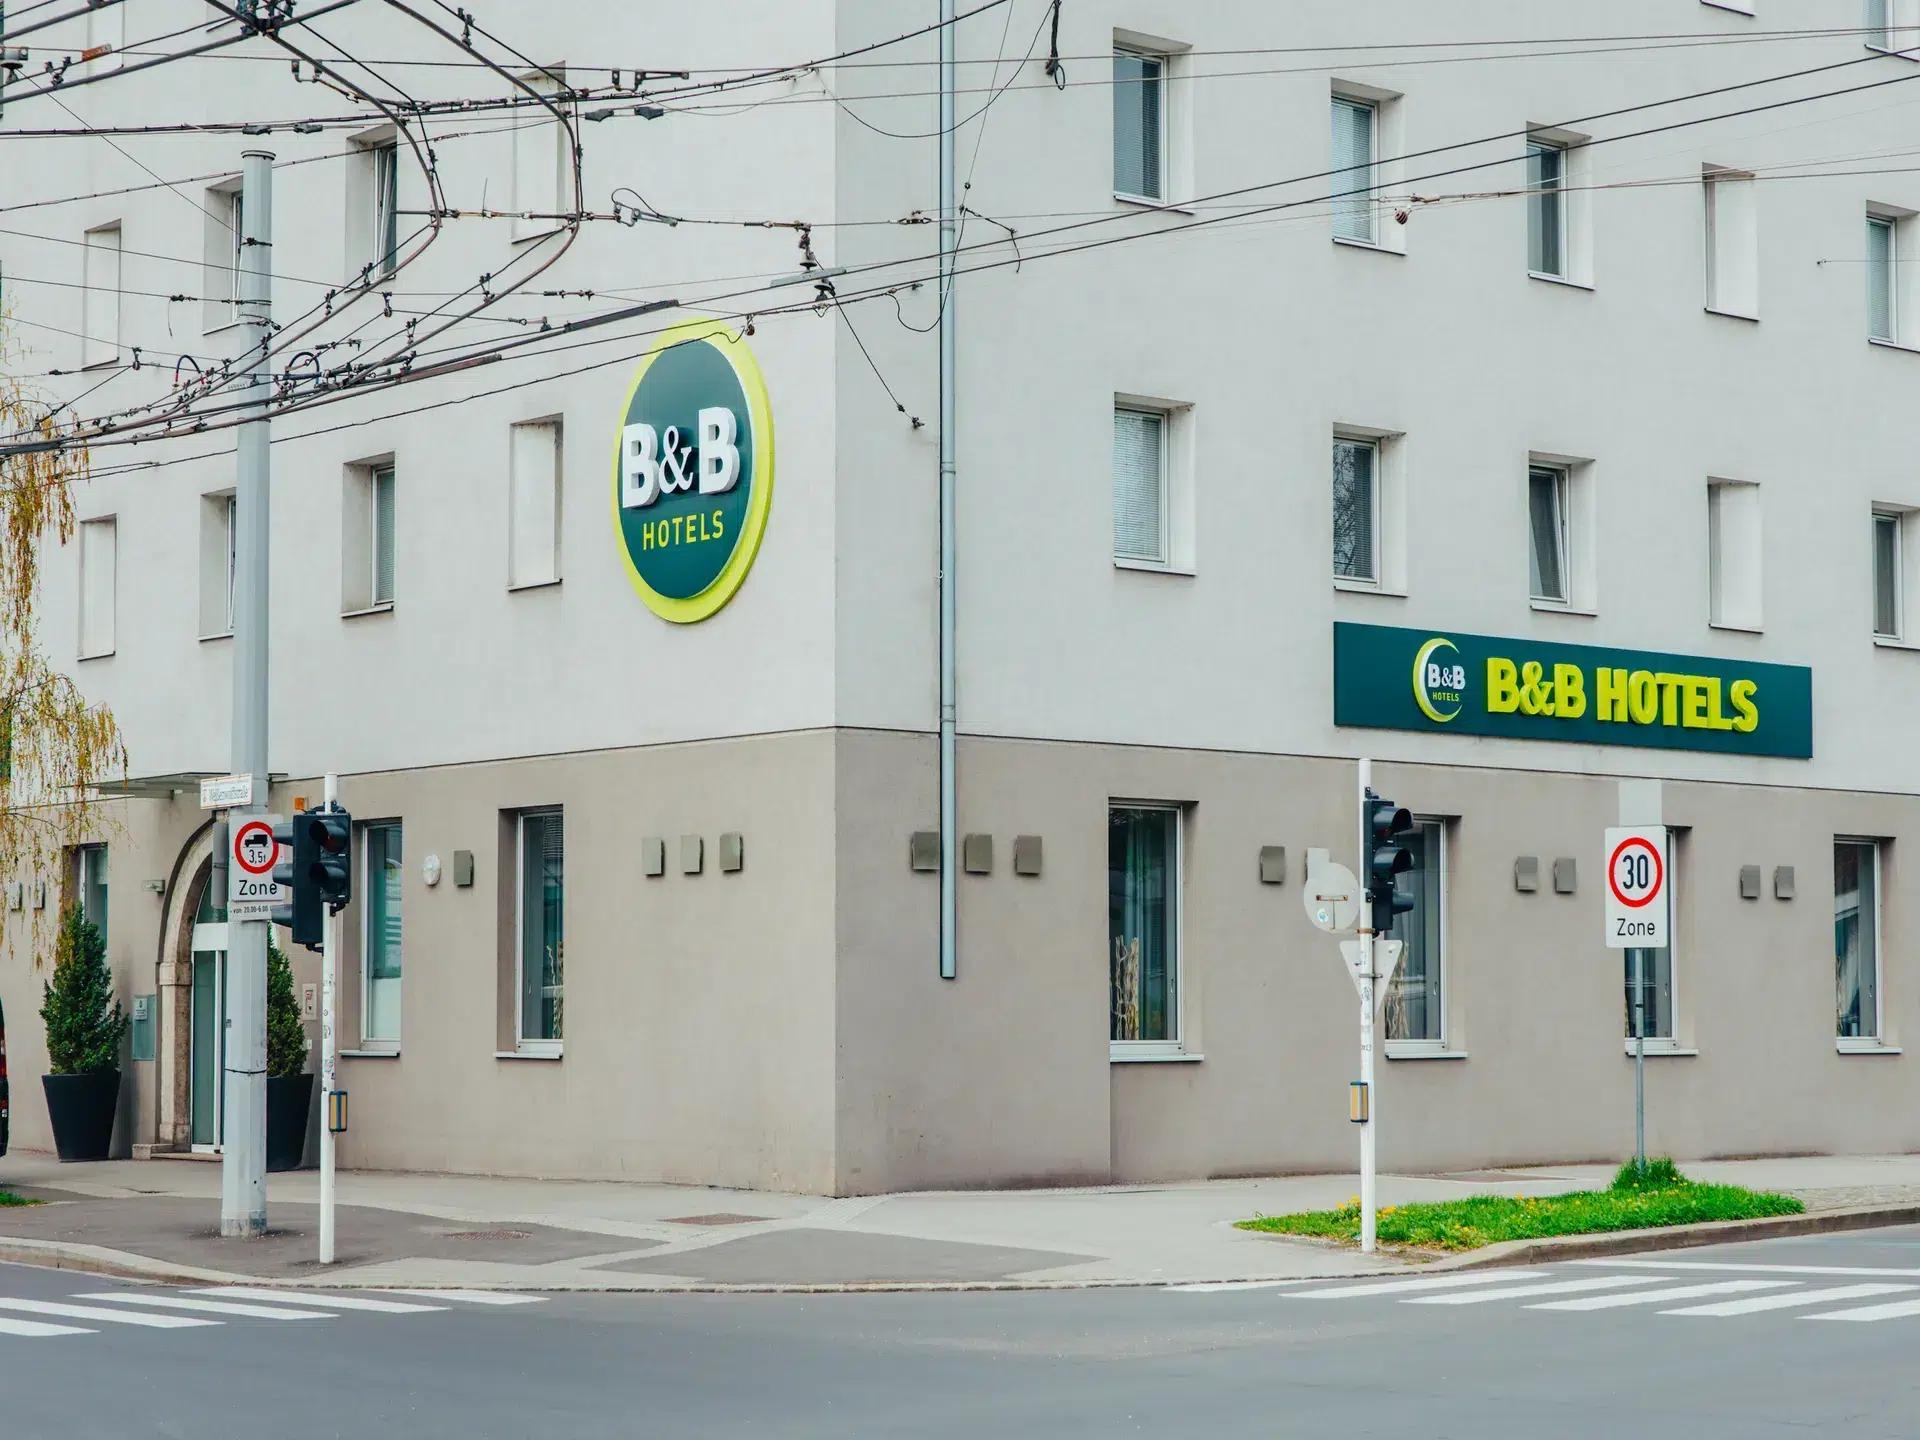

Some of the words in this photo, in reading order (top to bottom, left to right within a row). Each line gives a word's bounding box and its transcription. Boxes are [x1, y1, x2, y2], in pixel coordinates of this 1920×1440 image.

[622, 406, 741, 508] B&B
[643, 510, 724, 551] HOTELS
[1428, 663, 1466, 690] B&B
[1432, 691, 1460, 702] HOTELS
[1486, 657, 1587, 719] B&B
[1596, 667, 1758, 733] HOTELS
[1622, 854, 1649, 889] 30
[239, 880, 278, 896] Zone
[1616, 918, 1656, 936] Zone
